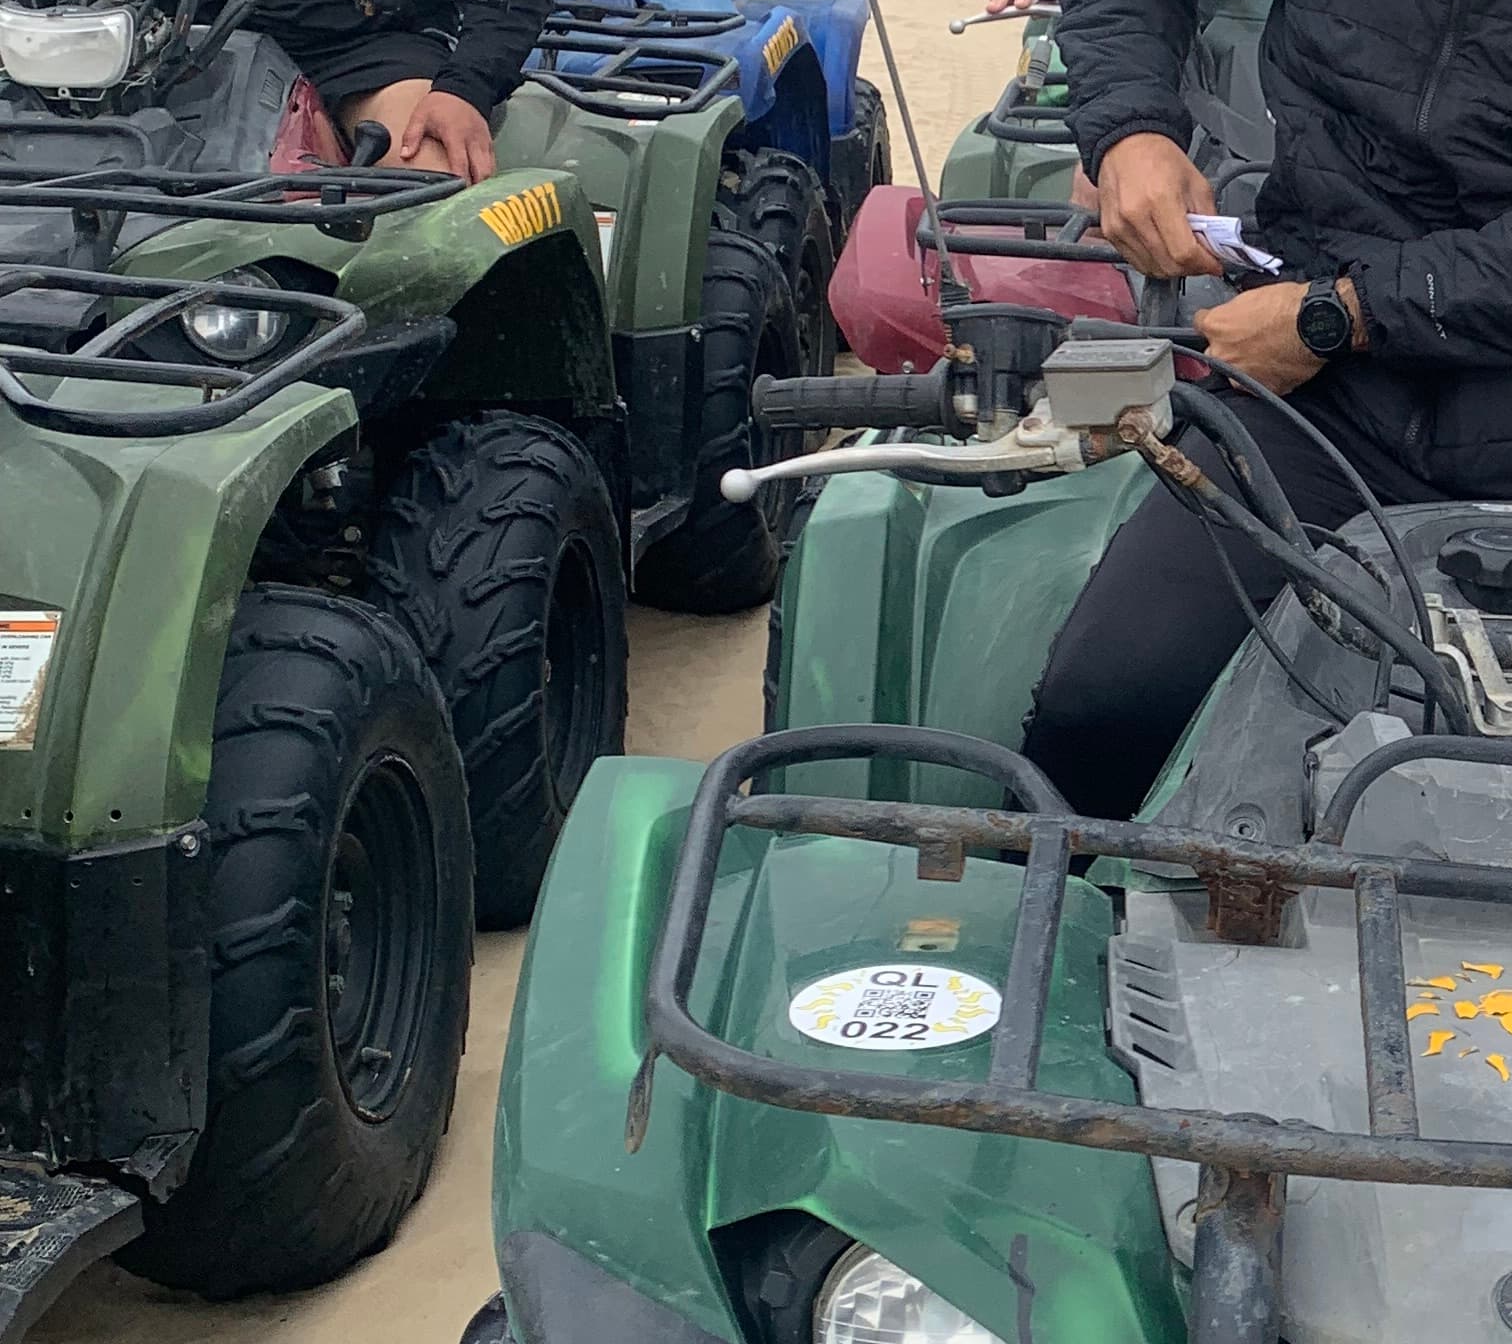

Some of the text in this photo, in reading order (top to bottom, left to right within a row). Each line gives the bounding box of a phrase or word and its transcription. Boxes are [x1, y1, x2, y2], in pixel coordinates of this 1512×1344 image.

[479, 181, 561, 246] ABBOTT
[870, 970, 939, 988] QL
[840, 1021, 930, 1041] 022
